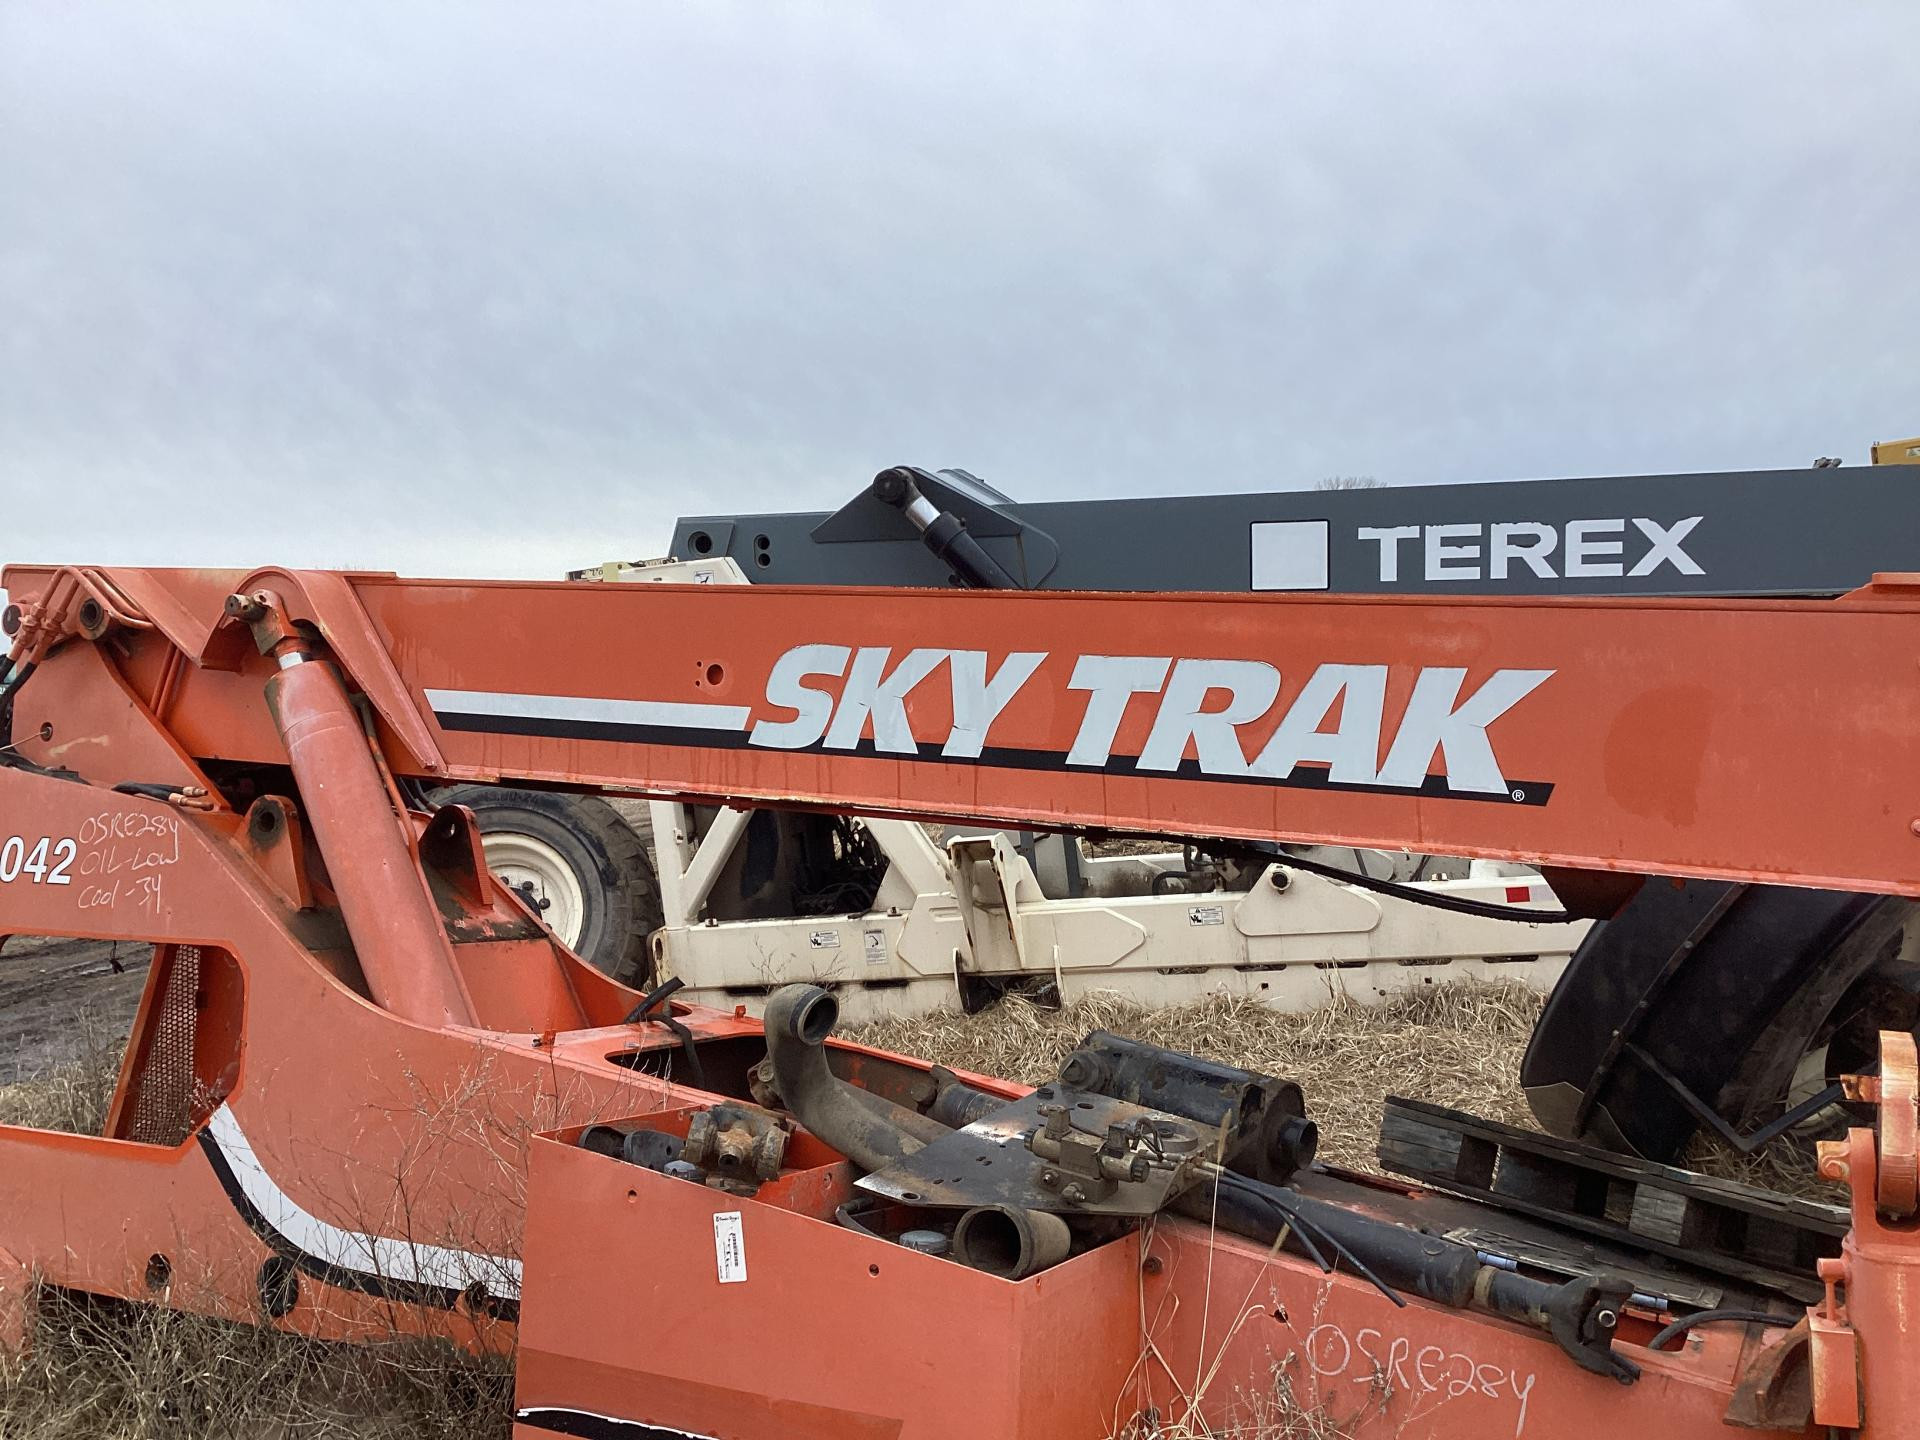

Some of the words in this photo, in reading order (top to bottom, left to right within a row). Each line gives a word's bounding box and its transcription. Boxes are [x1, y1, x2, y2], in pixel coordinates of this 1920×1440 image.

[1357, 516, 1706, 582] TEREX
[748, 643, 1050, 758] SKY
[1065, 655, 1558, 795] TRAK
[0, 836, 77, 885] 042
